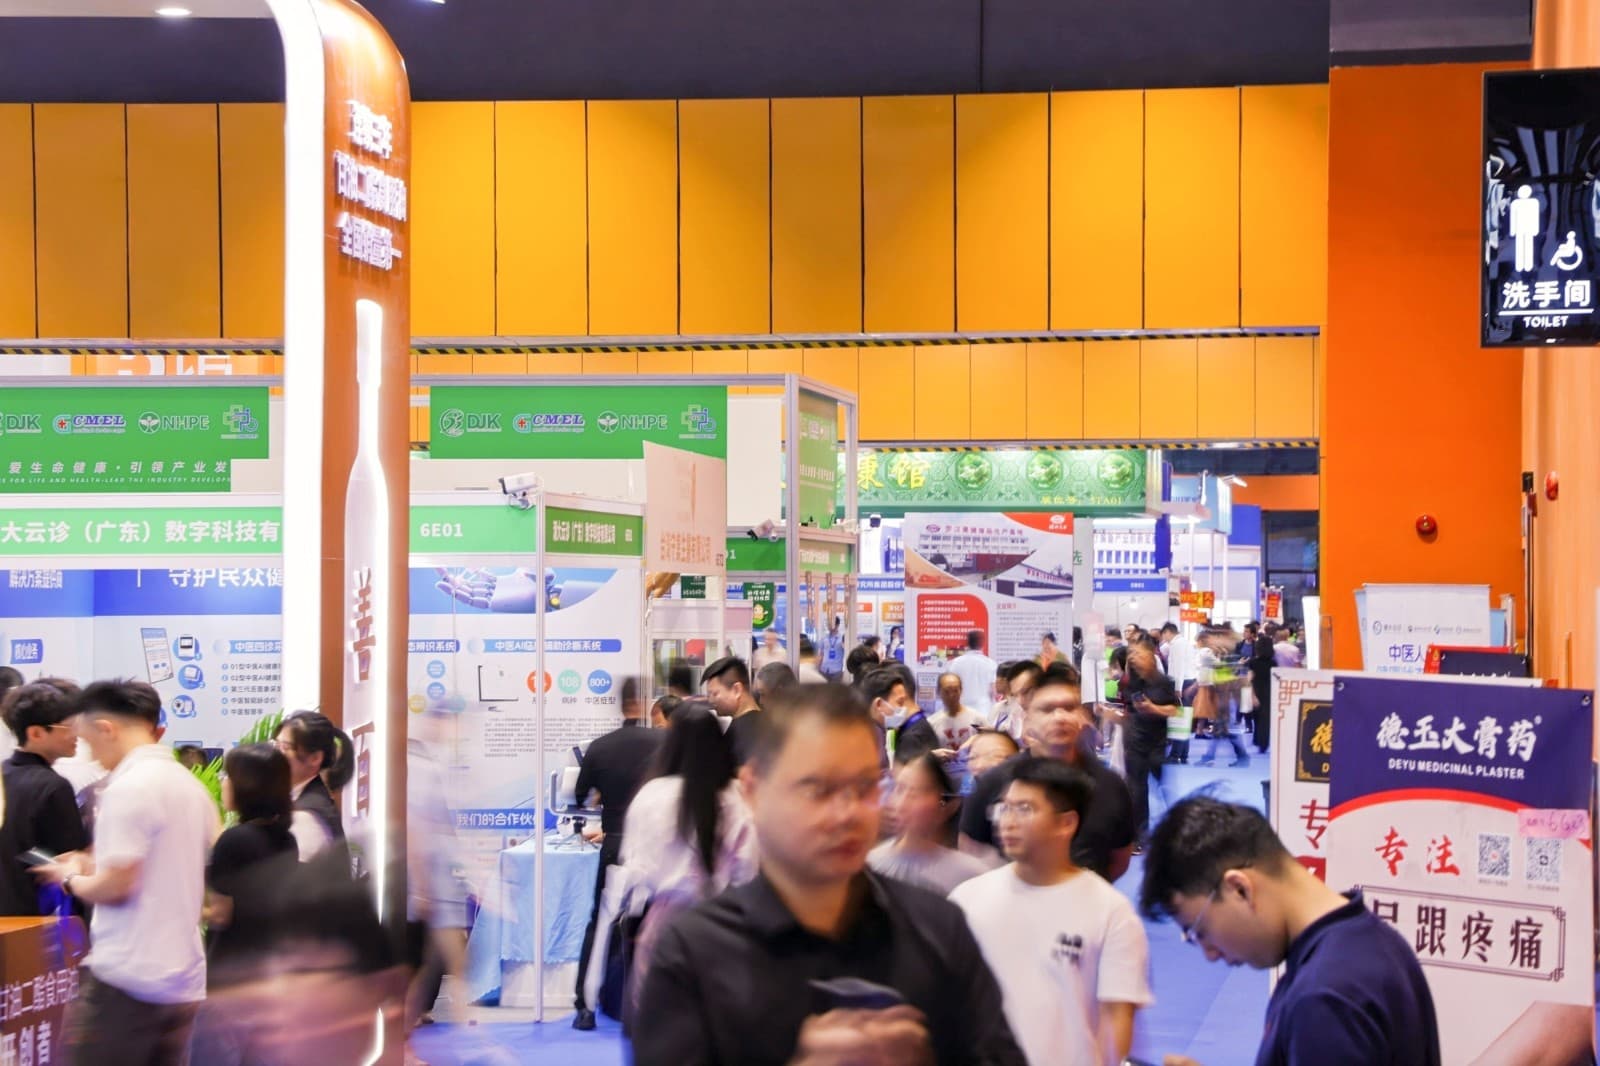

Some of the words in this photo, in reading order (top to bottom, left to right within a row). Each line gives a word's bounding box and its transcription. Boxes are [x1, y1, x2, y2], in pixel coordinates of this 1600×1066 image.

[1502, 280, 1591, 309] 洗手间
[1523, 316, 1569, 328] TOILET
[6, 414, 41, 430] DJK
[73, 415, 125, 427] CMEL
[162, 415, 210, 431] NHPE
[466, 413, 502, 429] DJK
[532, 414, 585, 427] CMEL
[622, 415, 668, 431] NHPE
[420, 523, 464, 538] 6E01
[1376, 712, 1537, 763] 德玉大膏药
[1388, 758, 1416, 772] DEYU
[1418, 760, 1474, 777] MEDICINAL
[1476, 764, 1525, 780] PLASTER
[457, 813, 537, 826] 我们的合作伙
[1375, 826, 1461, 877] 专注
